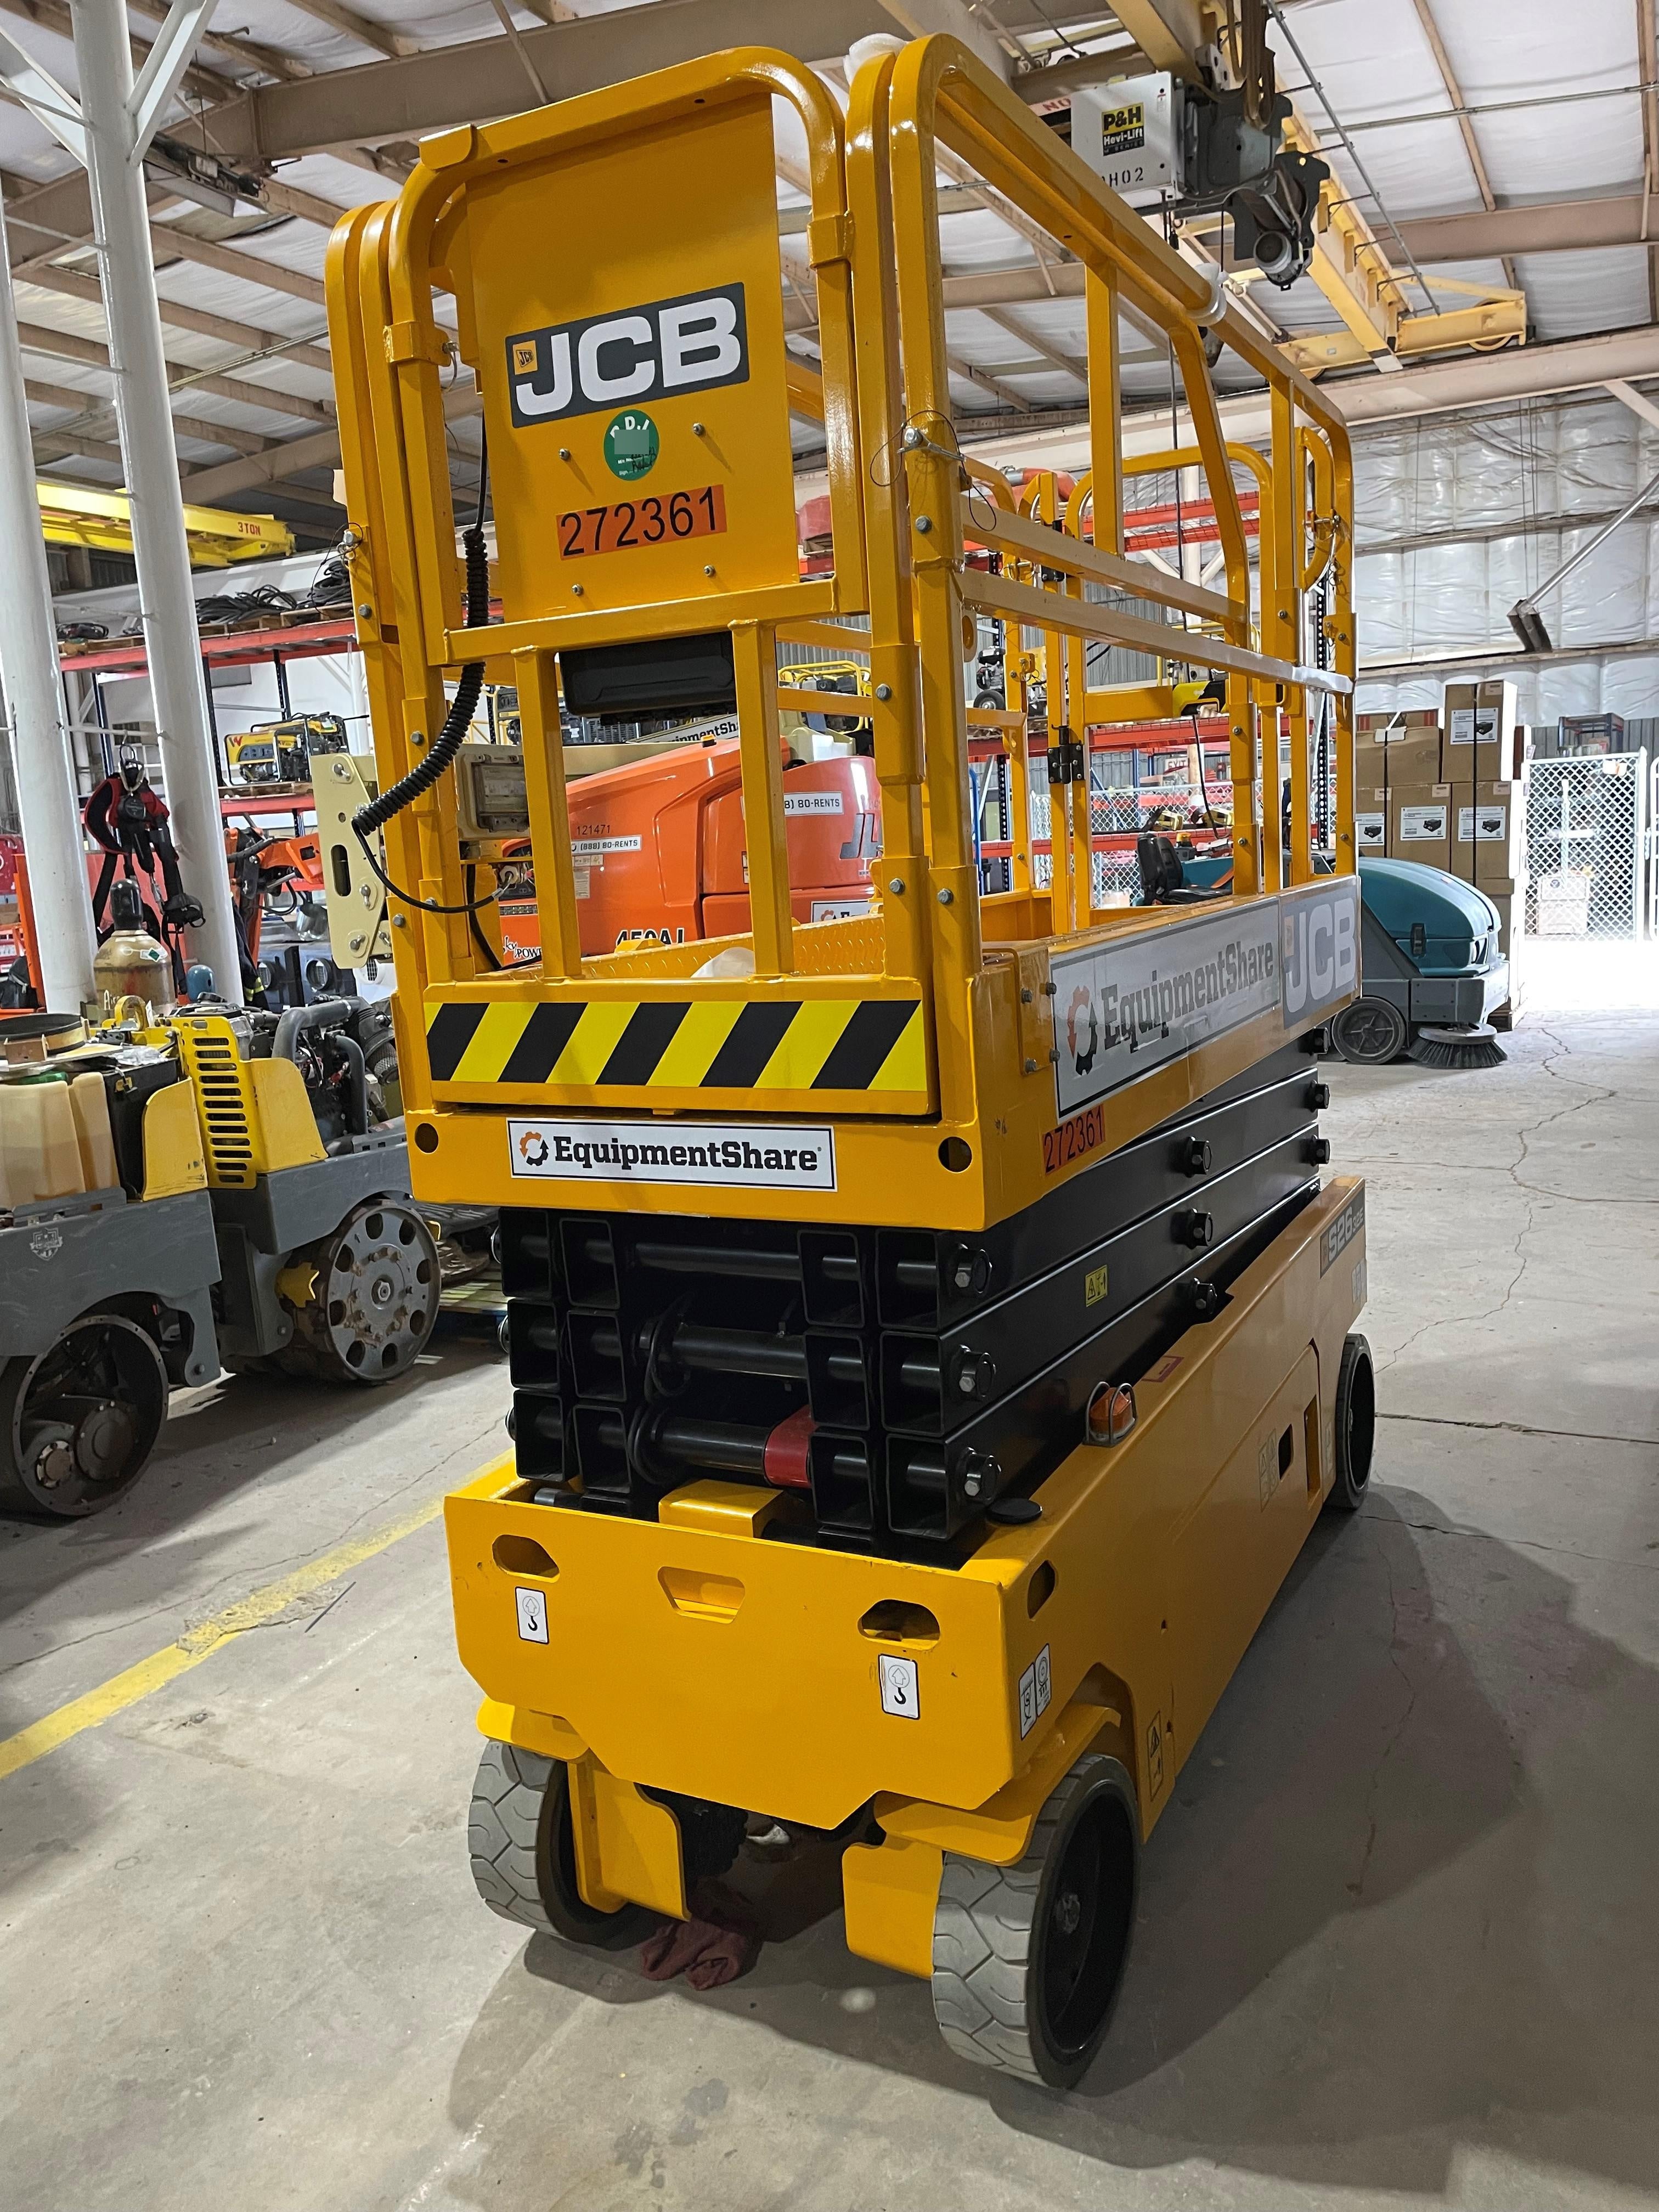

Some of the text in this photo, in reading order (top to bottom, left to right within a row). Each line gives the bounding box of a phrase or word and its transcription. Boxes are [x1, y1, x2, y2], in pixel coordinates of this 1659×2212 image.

[1104, 106, 1141, 131] P&H
[516, 297, 741, 415] JCB
[519, 351, 533, 365] JCB
[560, 486, 716, 557] 272361
[798, 799, 839, 808] 80-RENTS
[577, 825, 611, 835] 121471
[580, 840, 637, 851] (888) 80-RENTS
[840, 814, 883, 859] JL
[1101, 898, 1356, 1053] EquipmentShare JCB
[554, 1135, 818, 1171] EquipmentShare
[1044, 1109, 1104, 1173] 272361
